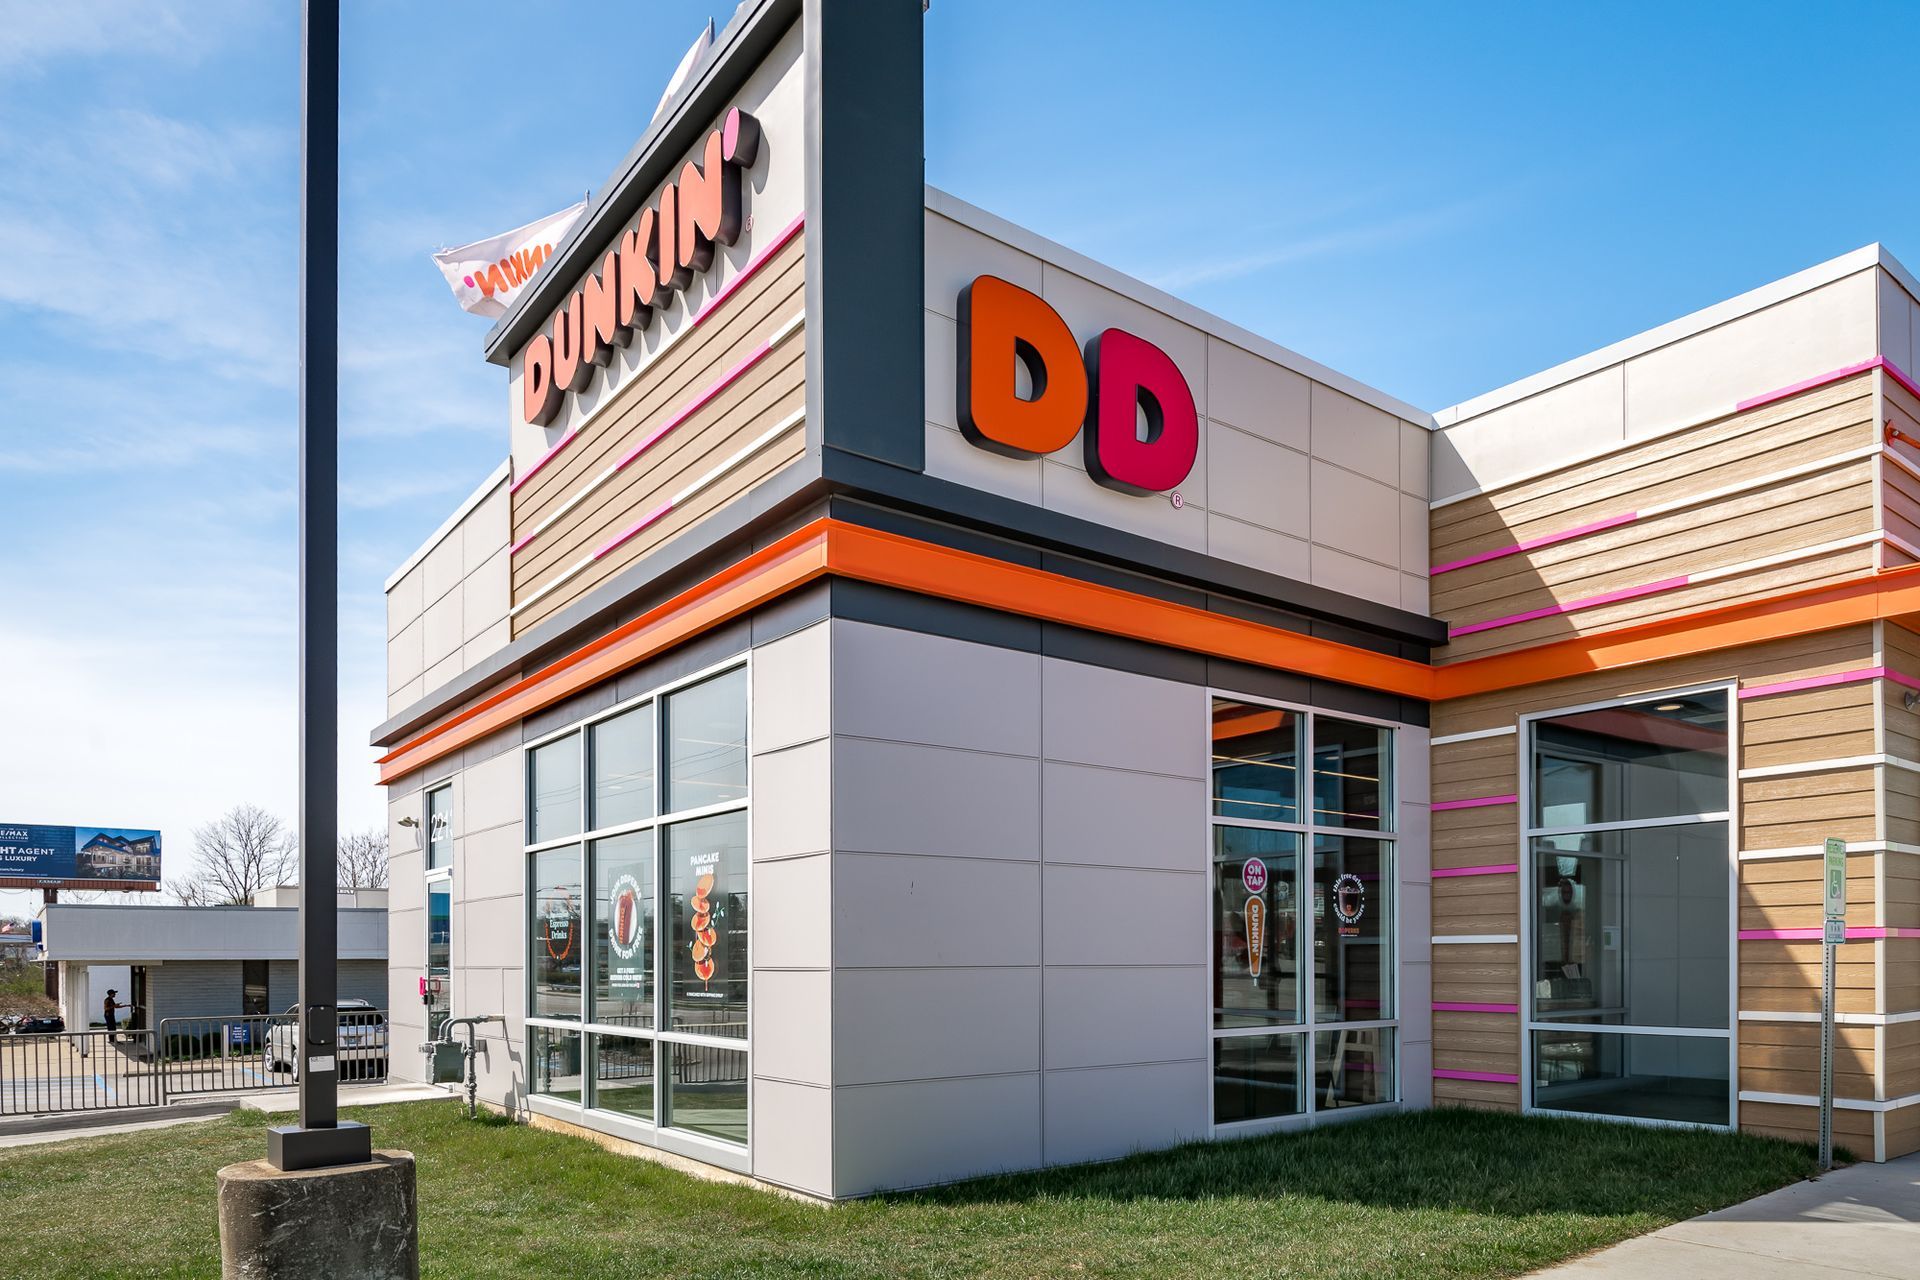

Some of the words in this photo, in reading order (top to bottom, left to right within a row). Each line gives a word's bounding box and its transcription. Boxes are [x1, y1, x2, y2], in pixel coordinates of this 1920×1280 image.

[524, 106, 757, 426] DUNKIN'
[956, 274, 1199, 497] DD
[690, 852, 720, 866] PANCAKE
[695, 864, 714, 877] MINIS
[1248, 865, 1261, 875] ON
[1247, 876, 1263, 886] TAP
[1341, 873, 1352, 881] free
[1352, 874, 1365, 894] drink
[1333, 903, 1346, 922] could
[1345, 916, 1352, 924] be
[549, 920, 569, 930] Espresso
[552, 931, 567, 939] Drinks
[621, 948, 634, 960] FOR
